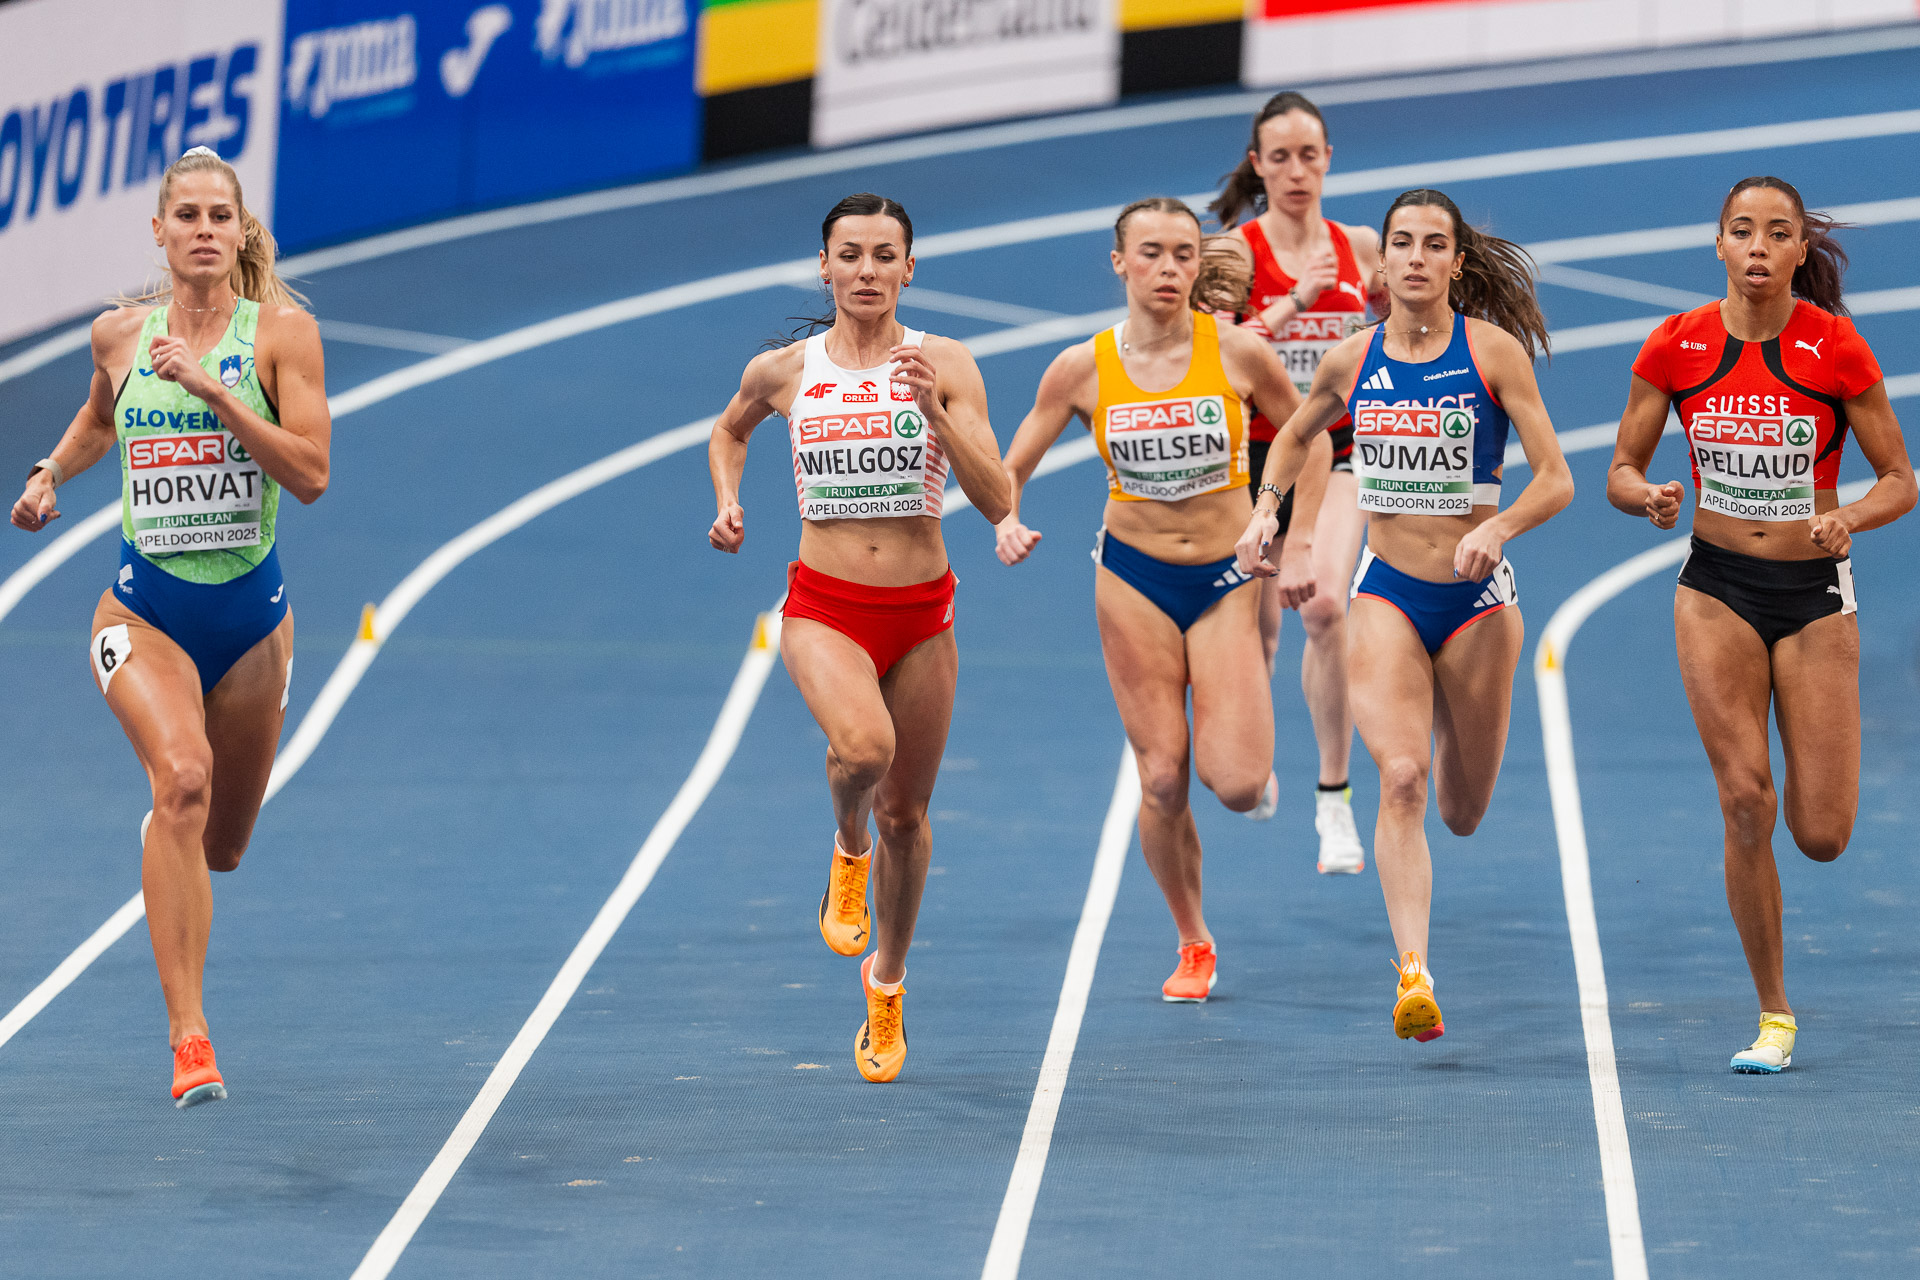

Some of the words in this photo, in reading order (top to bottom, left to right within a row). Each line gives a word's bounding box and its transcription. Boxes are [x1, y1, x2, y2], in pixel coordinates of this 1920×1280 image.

[1690, 342, 1707, 350] UBS
[1277, 349, 1327, 371] OFFM
[1448, 367, 1469, 376] Mutuel
[804, 383, 837, 399] 4F
[844, 394, 877, 402] ORLEN
[125, 408, 226, 430] SLOVEN
[802, 415, 889, 440] SPAR
[1111, 404, 1193, 430] SPAR
[1360, 413, 1438, 434] SPAR
[1695, 419, 1781, 443] SPAR
[132, 438, 222, 466] SPAR
[1110, 433, 1225, 462] NIELSEN
[1360, 443, 1468, 471] DUMAS
[799, 446, 923, 475] WIELGOSZ
[1697, 447, 1810, 479] PELLAUD
[133, 471, 258, 506] HORVAT
[826, 487, 830, 497] I
[831, 486, 857, 497] RUN
[1124, 481, 1195, 496] APELDOORN
[1200, 472, 1226, 487] 2025
[1377, 480, 1380, 489] I
[1380, 481, 1404, 491] RUN
[1725, 485, 1746, 498] RUN
[807, 502, 890, 515] APELDOORN
[893, 500, 923, 512] 2025
[1361, 494, 1435, 509] APELDOORN
[1438, 498, 1469, 509] 2025
[1704, 493, 1778, 516] APELDOORN
[1781, 503, 1811, 515] 2025
[157, 519, 161, 528] I
[163, 515, 188, 527] RUN
[139, 531, 224, 547] APELDOORN
[228, 528, 257, 541] 2025
[101, 635, 117, 673] 6
